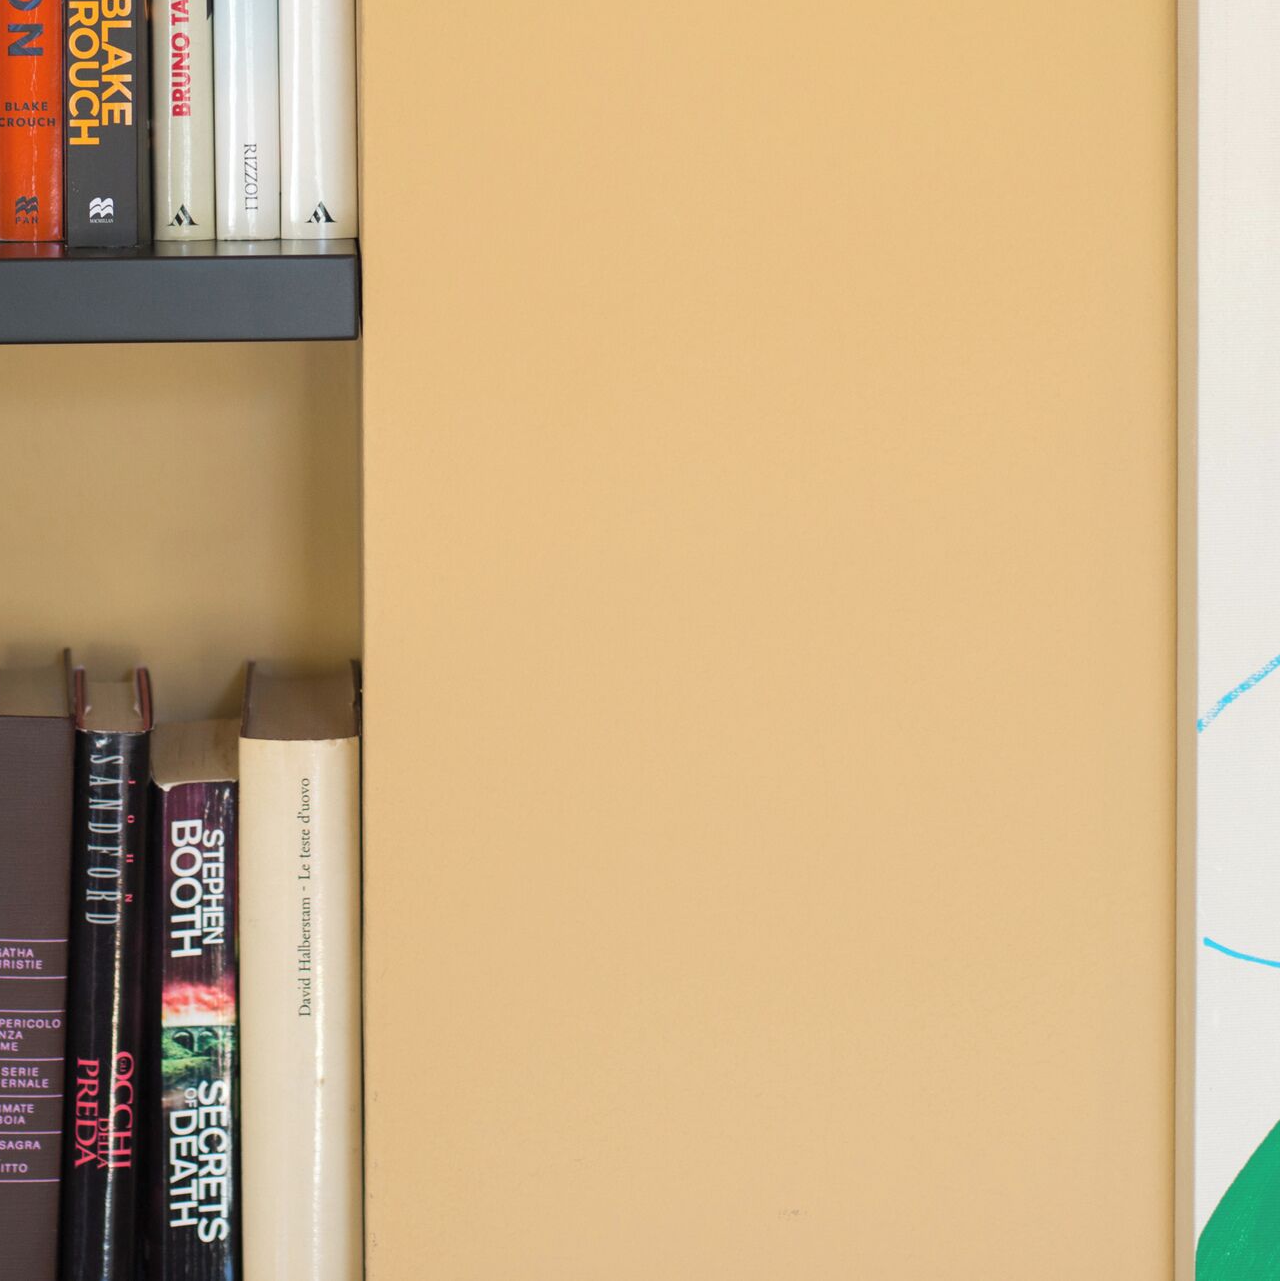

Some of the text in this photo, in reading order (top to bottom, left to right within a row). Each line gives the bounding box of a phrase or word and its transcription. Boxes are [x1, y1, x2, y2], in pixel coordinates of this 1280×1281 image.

[5, 102, 48, 111] BLAKE
[170, 30, 190, 117] BRUNO
[244, 143, 258, 211] RIZZOLI
[85, 754, 124, 925] SANDFORD
[299, 826, 310, 858] teste
[299, 863, 310, 880] Le
[170, 820, 202, 958] BOOTH
[202, 829, 224, 944] STEPHEN
[298, 898, 311, 969] Halberstam
[299, 974, 311, 1017] David
[73, 1059, 99, 1168] PREDA
[170, 1110, 197, 1227] DEATH
[196, 1080, 226, 1243] SECRETS
